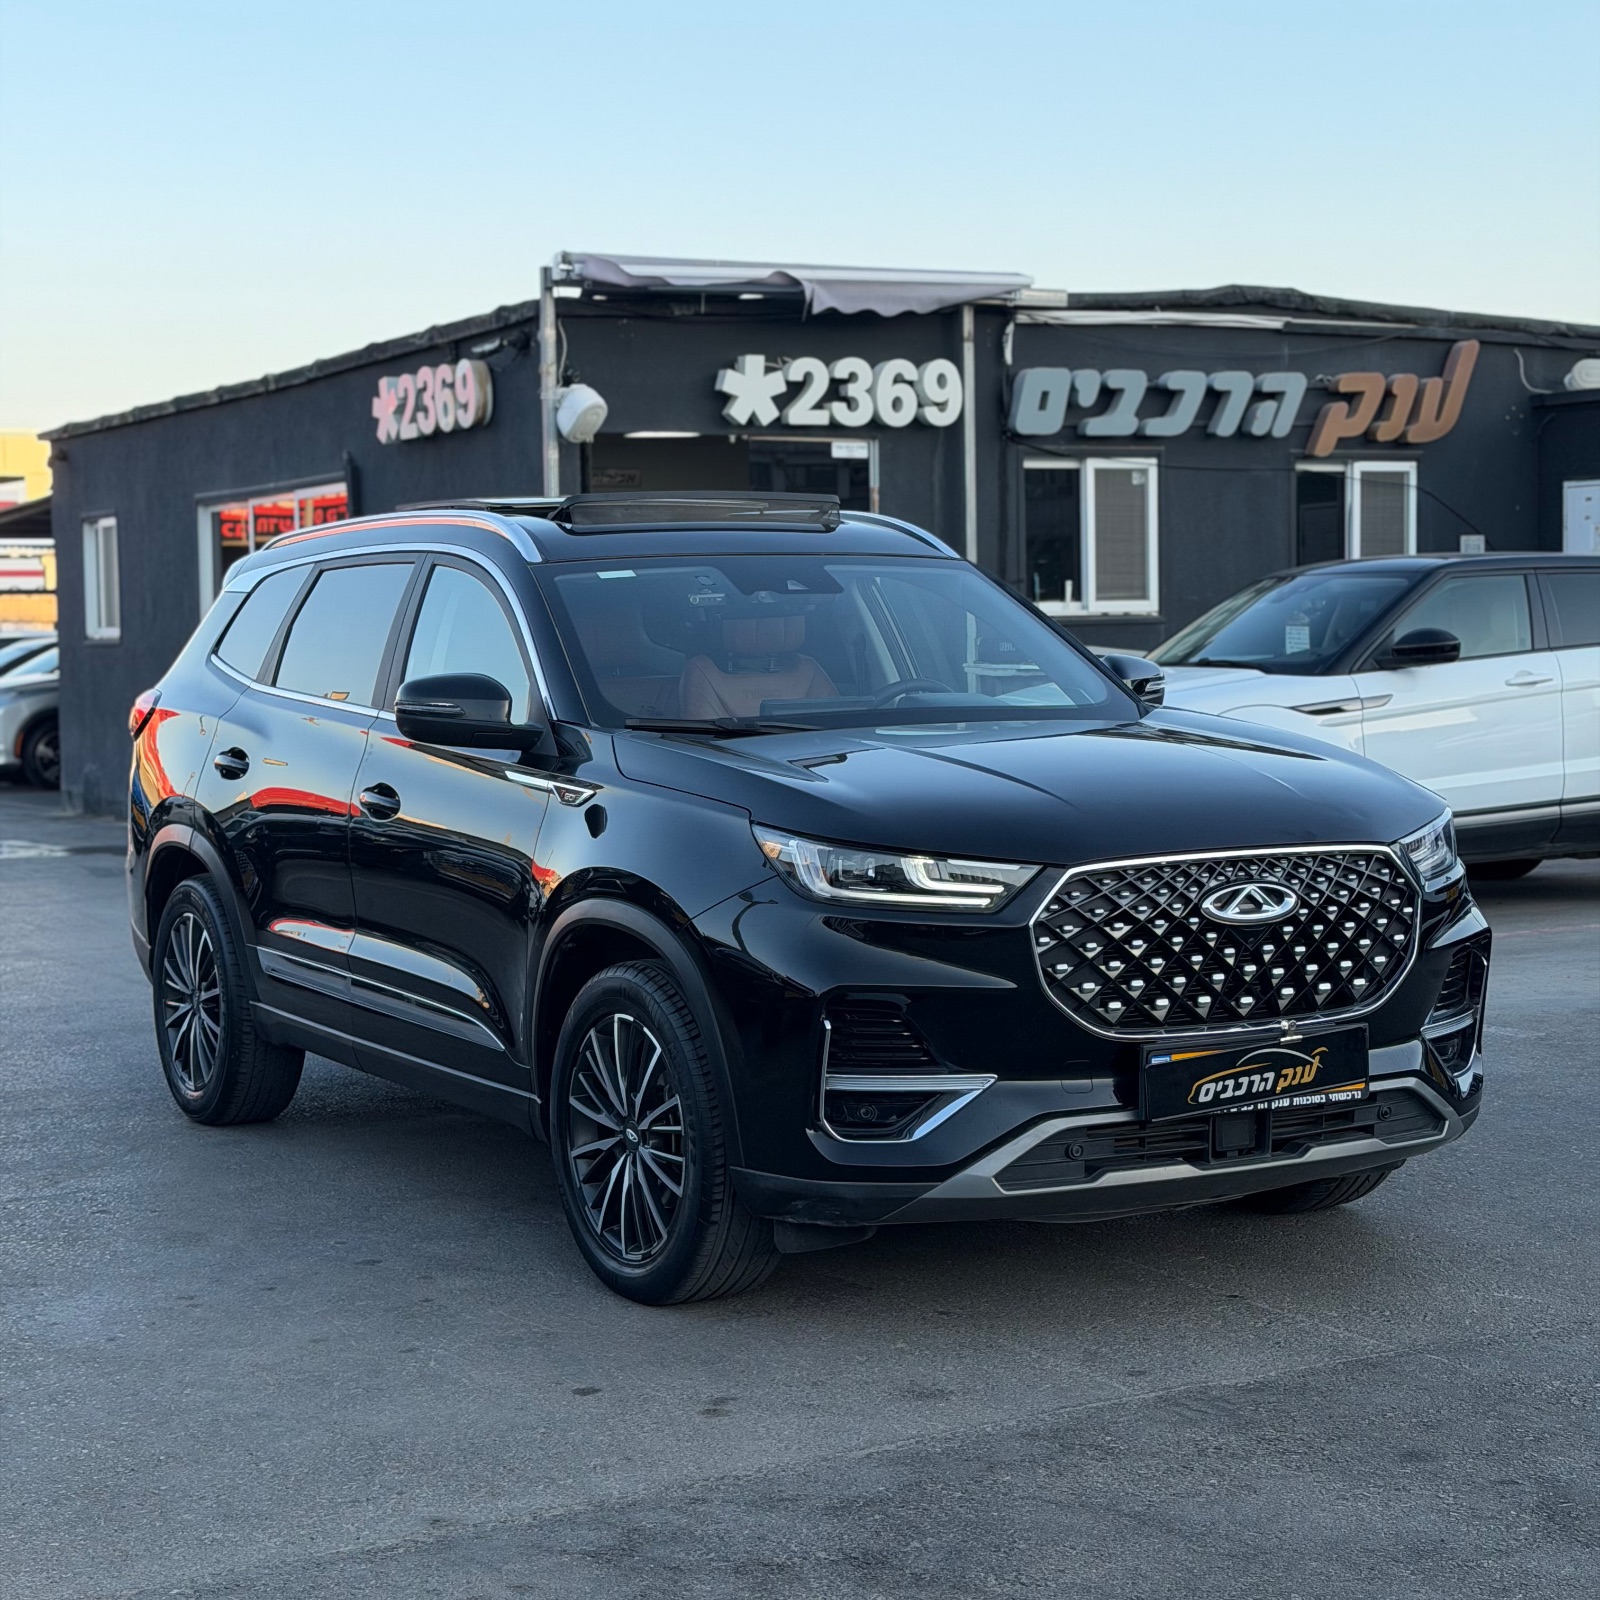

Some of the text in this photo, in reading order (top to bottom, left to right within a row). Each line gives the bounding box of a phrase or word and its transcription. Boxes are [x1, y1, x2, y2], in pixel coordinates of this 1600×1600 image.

[1012, 339, 1480, 457] ענק הרכבים
[1198, 1055, 1320, 1103] ענק הרכבים
[1293, 1095, 1326, 1106] בסוכנות
[1328, 1090, 1362, 1102] נרכשתי
